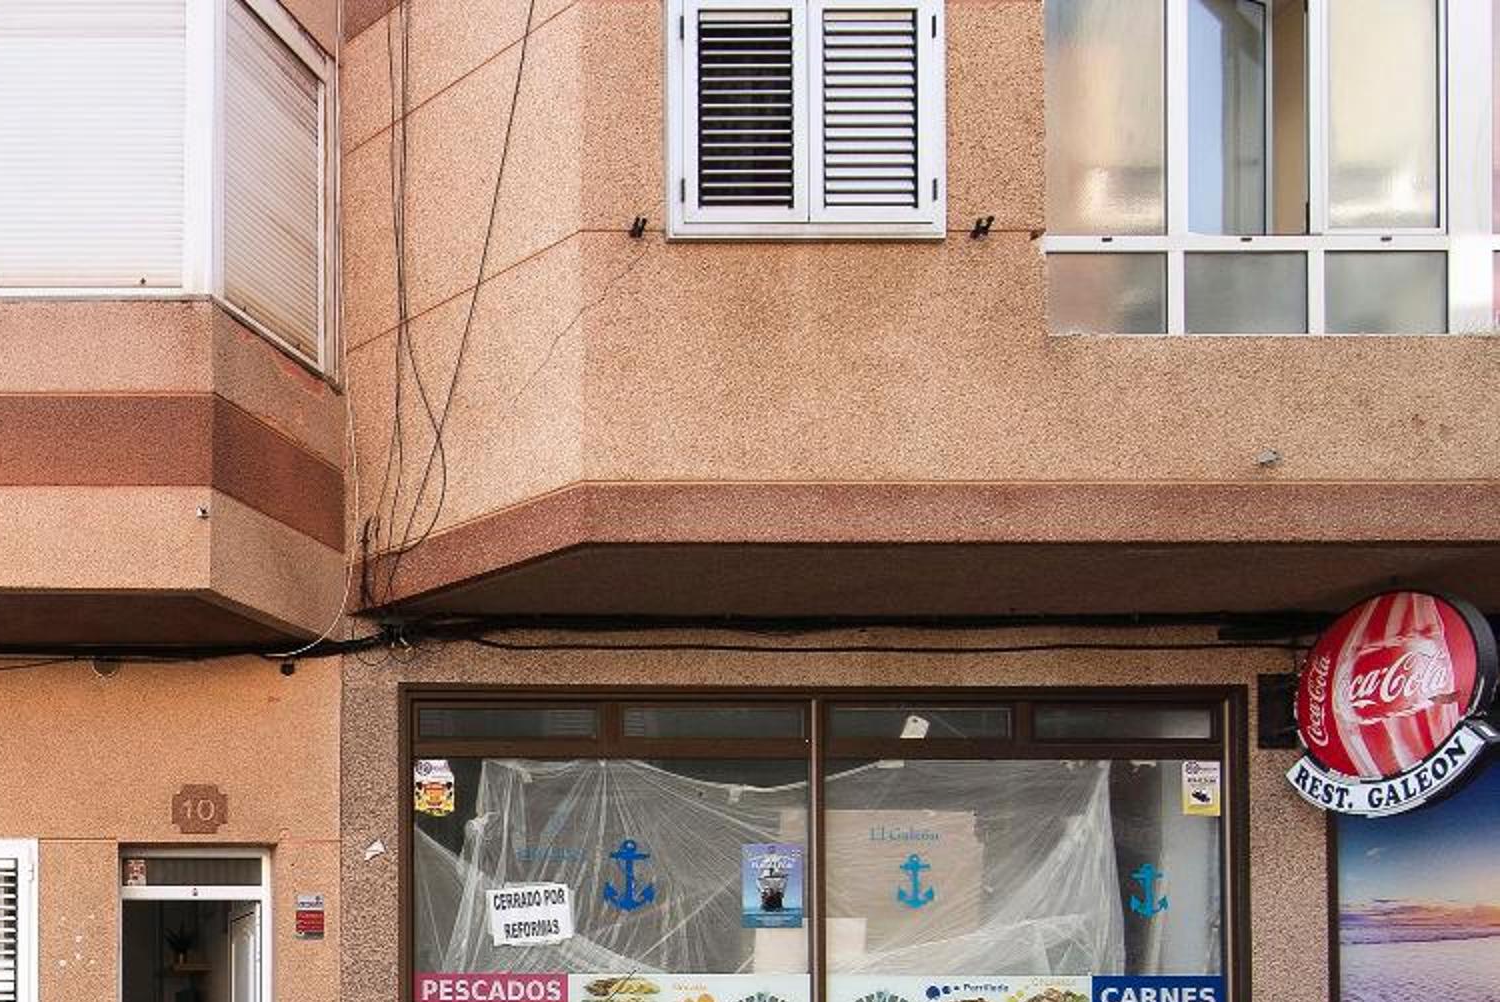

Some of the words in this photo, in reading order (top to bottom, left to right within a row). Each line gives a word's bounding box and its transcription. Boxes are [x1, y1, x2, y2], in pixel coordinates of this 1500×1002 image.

[1306, 655, 1331, 747] Coca-Cola
[1294, 763, 1353, 809] REST.
[1367, 736, 1467, 809] GALEON
[180, 799, 216, 822] 10
[493, 890, 542, 911] CERRADO
[543, 887, 566, 905] POR
[503, 919, 561, 939] REFORMAS
[420, 978, 562, 1002] PESCADOS
